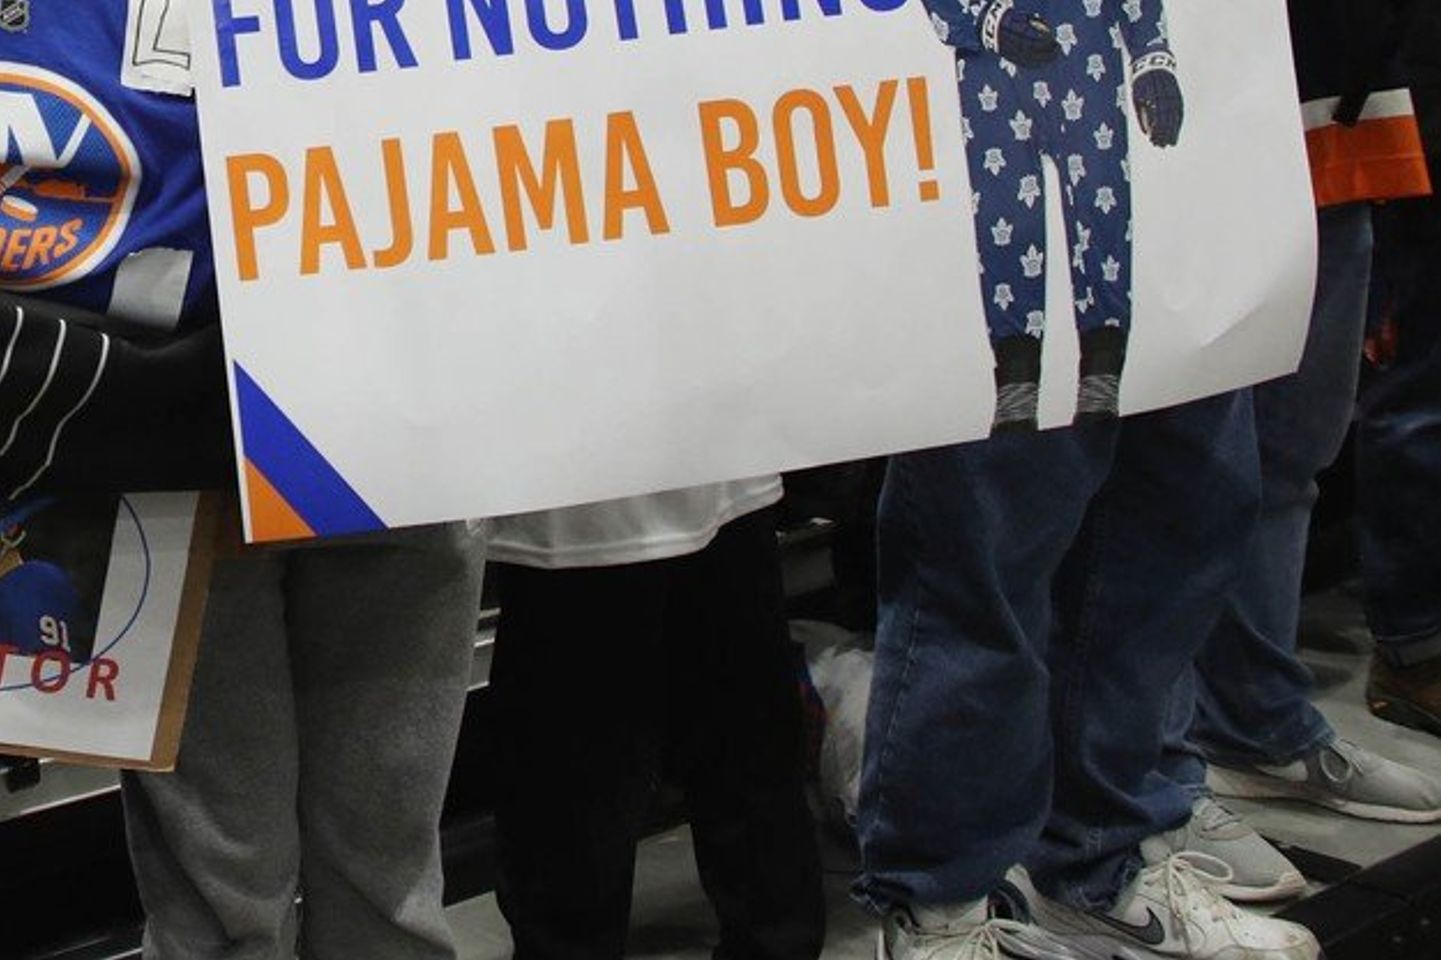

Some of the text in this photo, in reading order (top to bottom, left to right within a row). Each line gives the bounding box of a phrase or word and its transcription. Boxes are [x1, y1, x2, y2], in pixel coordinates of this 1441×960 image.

[226, 76, 940, 281] PAJAMA BOY!
[39, 615, 71, 653] 91
